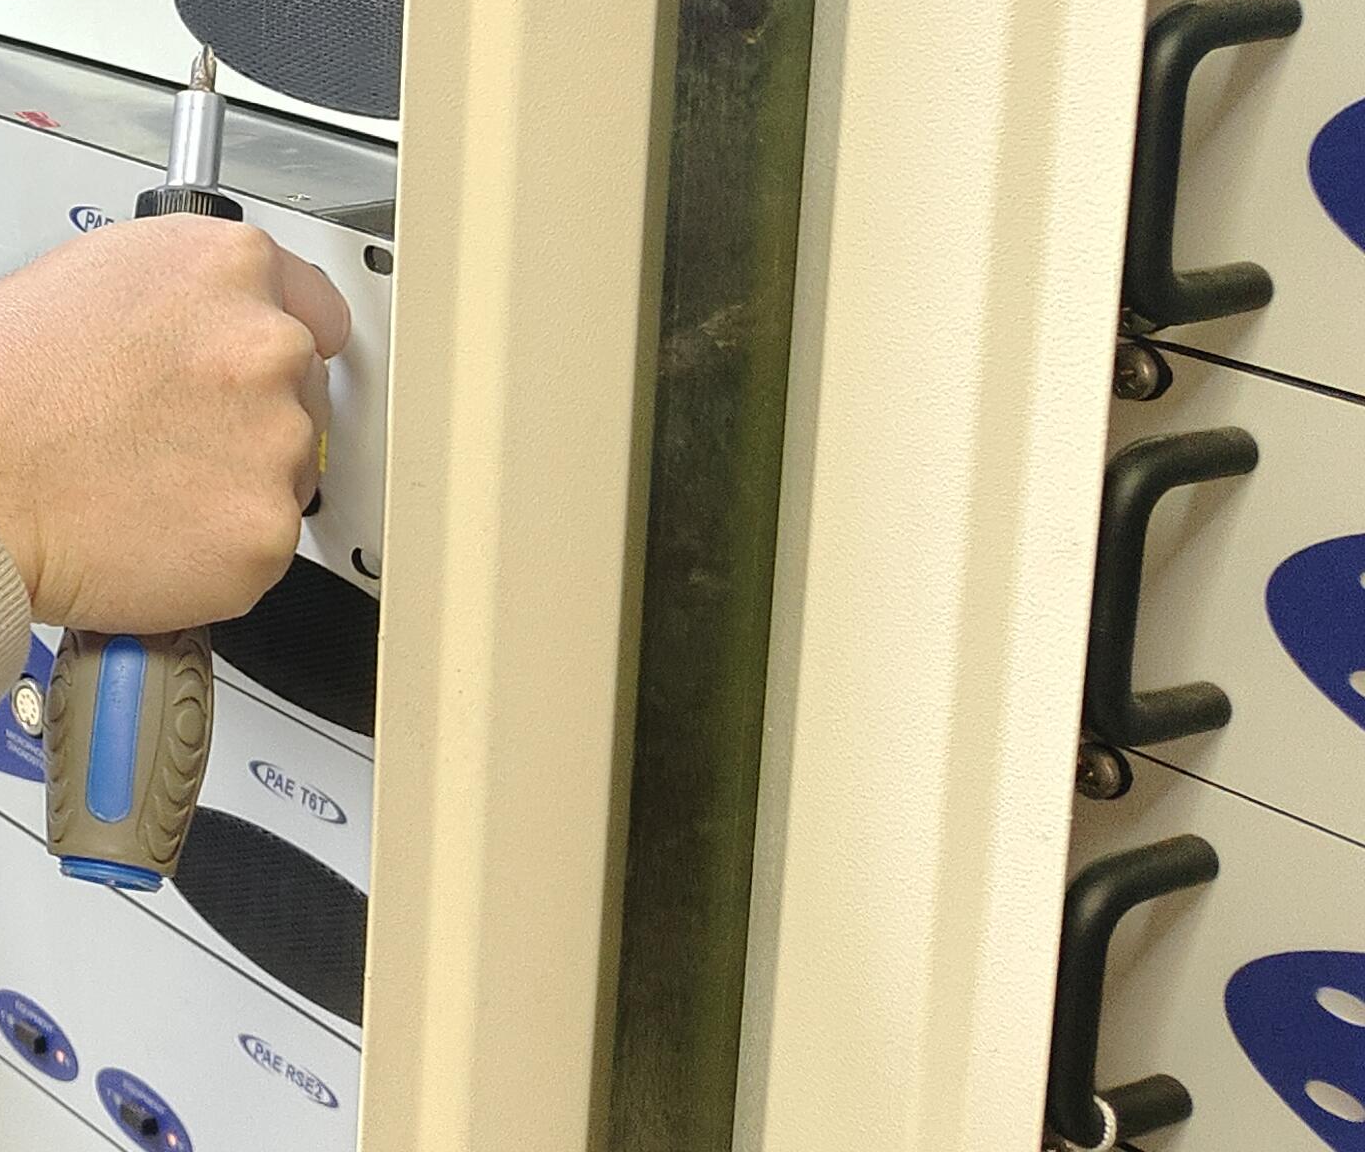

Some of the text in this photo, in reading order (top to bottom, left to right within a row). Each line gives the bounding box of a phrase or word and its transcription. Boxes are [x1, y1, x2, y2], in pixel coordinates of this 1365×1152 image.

[265, 768, 328, 815] PAE T6T
[254, 1042, 283, 1073] PAE
